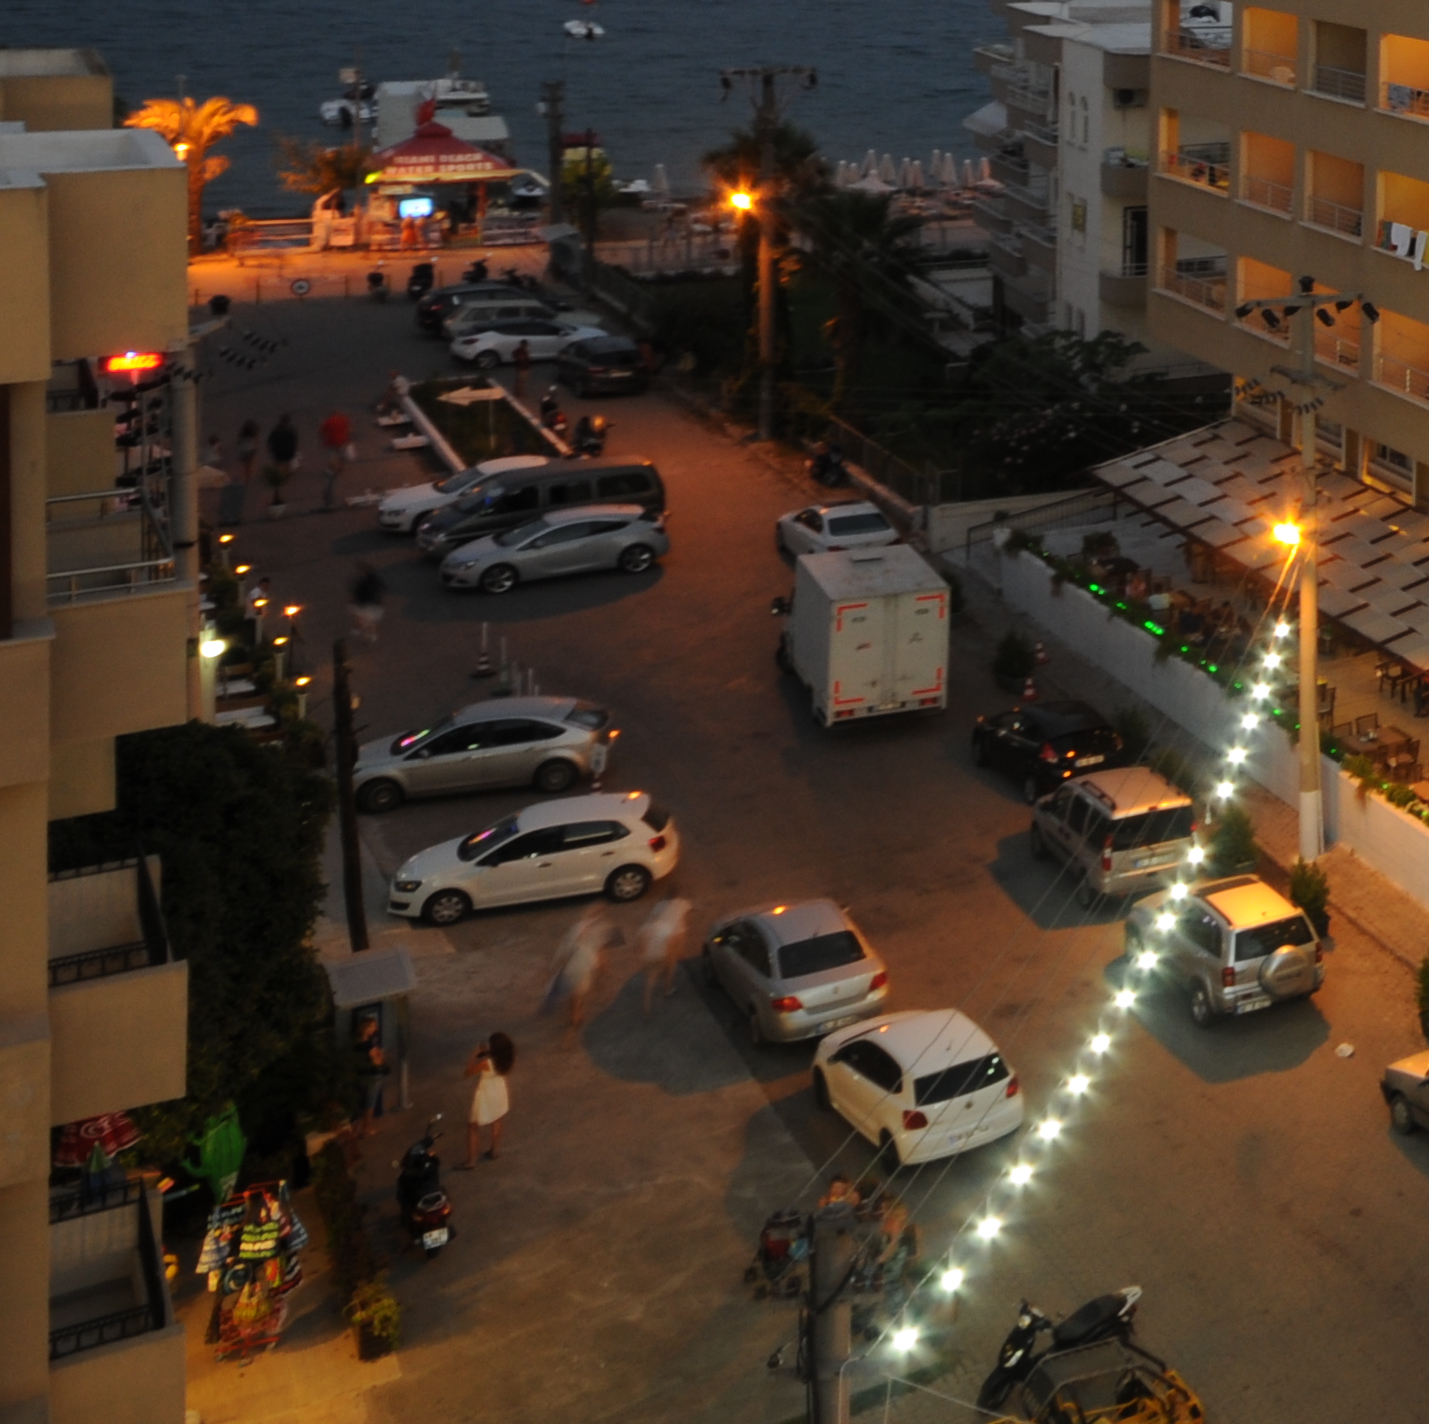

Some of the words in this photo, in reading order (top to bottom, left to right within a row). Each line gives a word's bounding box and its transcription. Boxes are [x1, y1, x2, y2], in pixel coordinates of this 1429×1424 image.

[439, 153, 483, 162] BEACH
[386, 165, 434, 174] WATER
[439, 163, 493, 172] SPORTS
